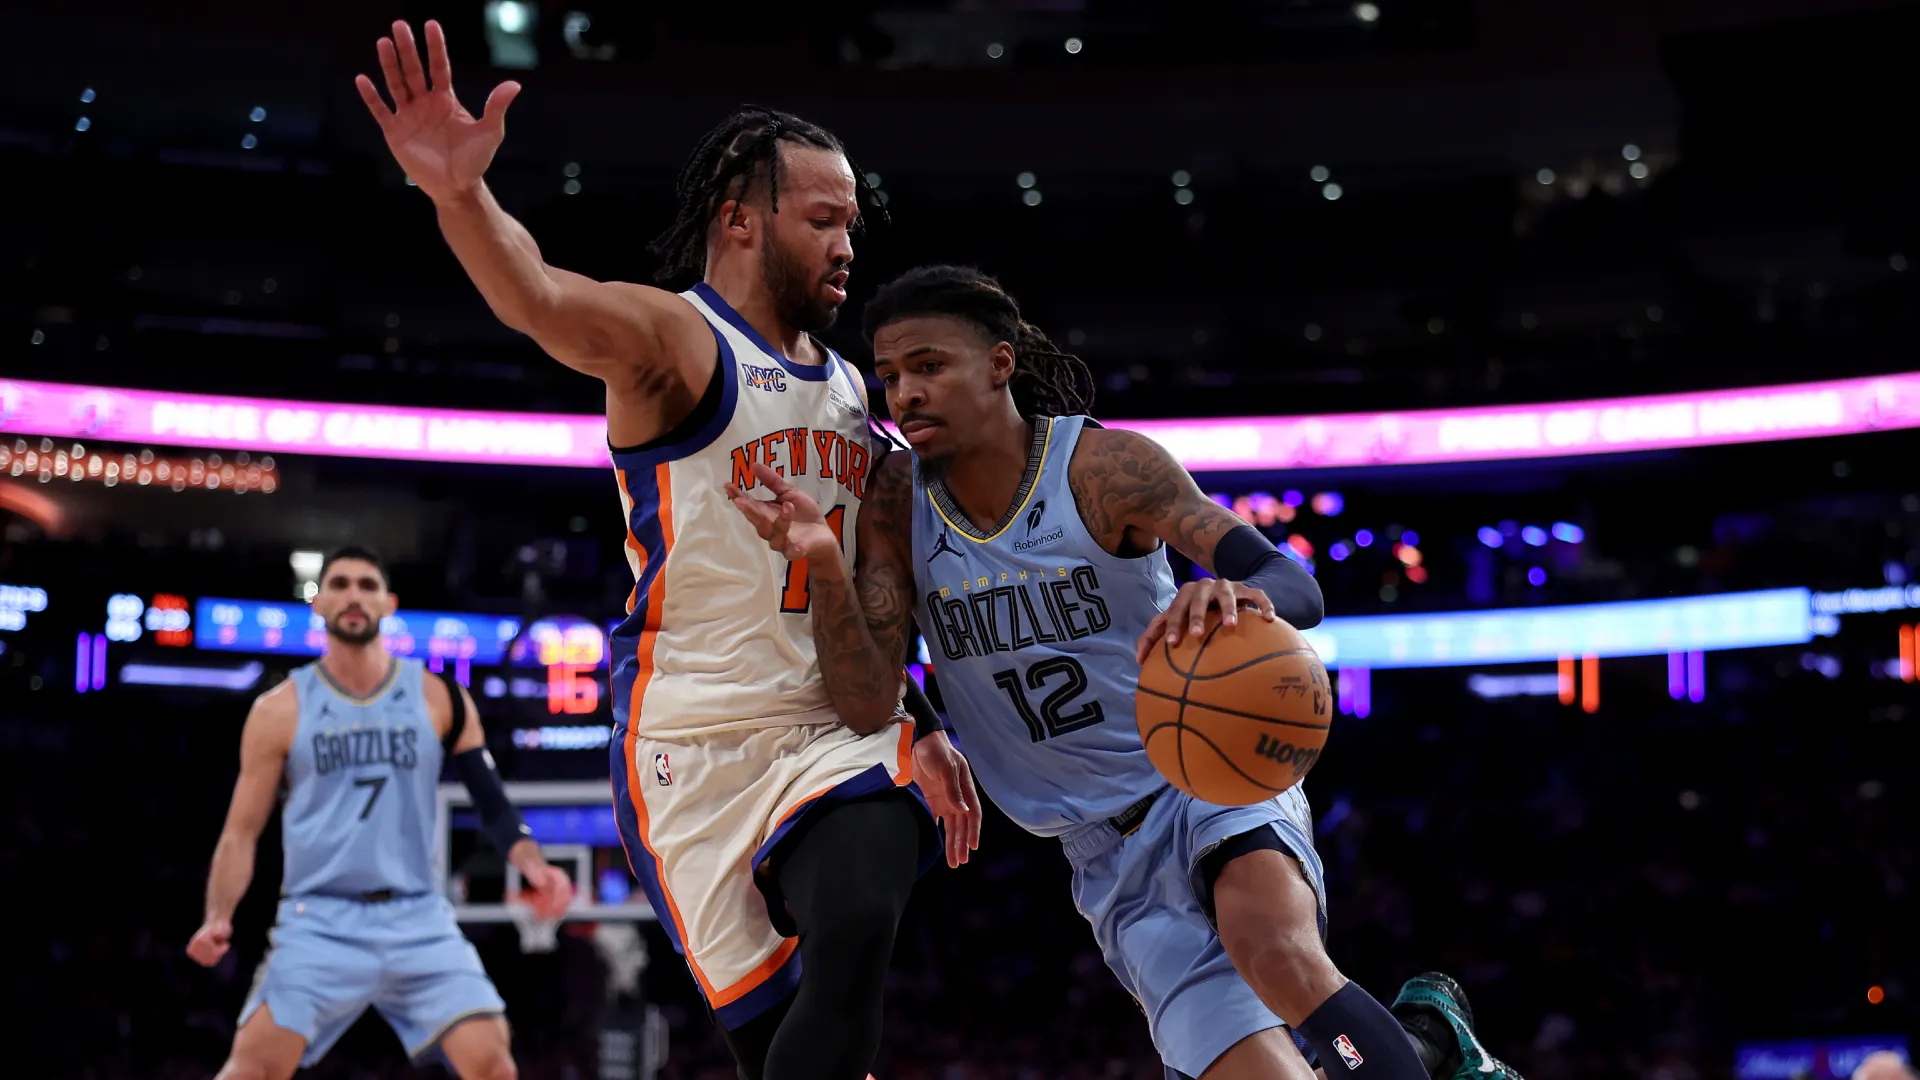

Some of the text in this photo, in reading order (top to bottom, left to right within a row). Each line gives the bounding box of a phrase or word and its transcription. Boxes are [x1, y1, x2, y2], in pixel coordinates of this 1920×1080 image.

[741, 363, 787, 392] NYC
[729, 428, 876, 501] NEW YOR
[1014, 528, 1063, 551] Robinhood
[927, 565, 1111, 661] GRIZZLIES
[992, 656, 1105, 742] 12
[353, 776, 388, 822] 7
